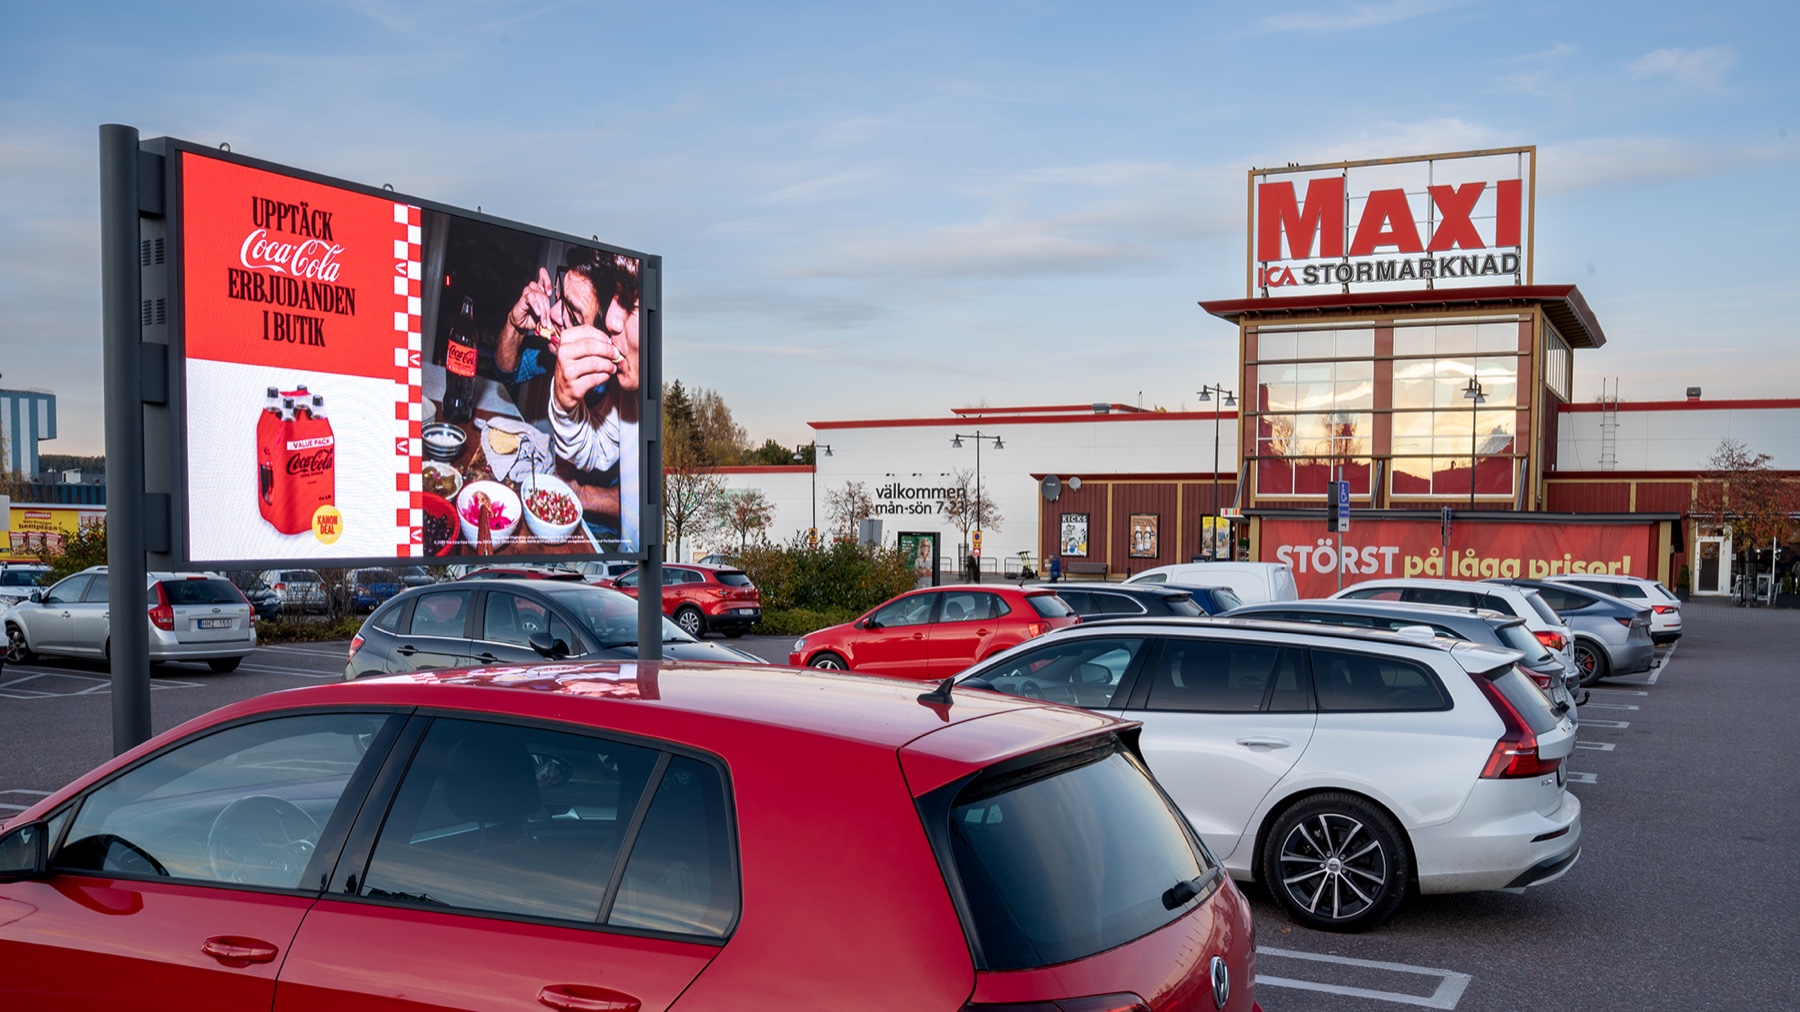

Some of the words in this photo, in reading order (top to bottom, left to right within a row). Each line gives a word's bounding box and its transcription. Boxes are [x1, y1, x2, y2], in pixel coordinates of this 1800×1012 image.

[252, 195, 334, 242] UPPTÄCK
[1257, 176, 1522, 262] MAXI
[240, 228, 345, 282] Coca-Cola
[1257, 265, 1298, 289] ICA
[1302, 252, 1521, 286] STORMARKNAD
[227, 267, 356, 317] ERBJUDANDEN
[262, 310, 270, 340] I
[273, 312, 326, 347] BUTIK
[286, 447, 333, 476] Coca-Cola
[293, 440, 313, 449] VALUE
[314, 438, 330, 447] PACK
[875, 482, 966, 499] välkommen
[875, 500, 932, 514] mån-sön
[317, 515, 338, 525] KANON
[320, 524, 335, 534] DEAL
[1276, 538, 1399, 574] STÖRST
[1404, 546, 1443, 579] på
[1451, 548, 1521, 579] låga
[1529, 553, 1631, 579] priser!
